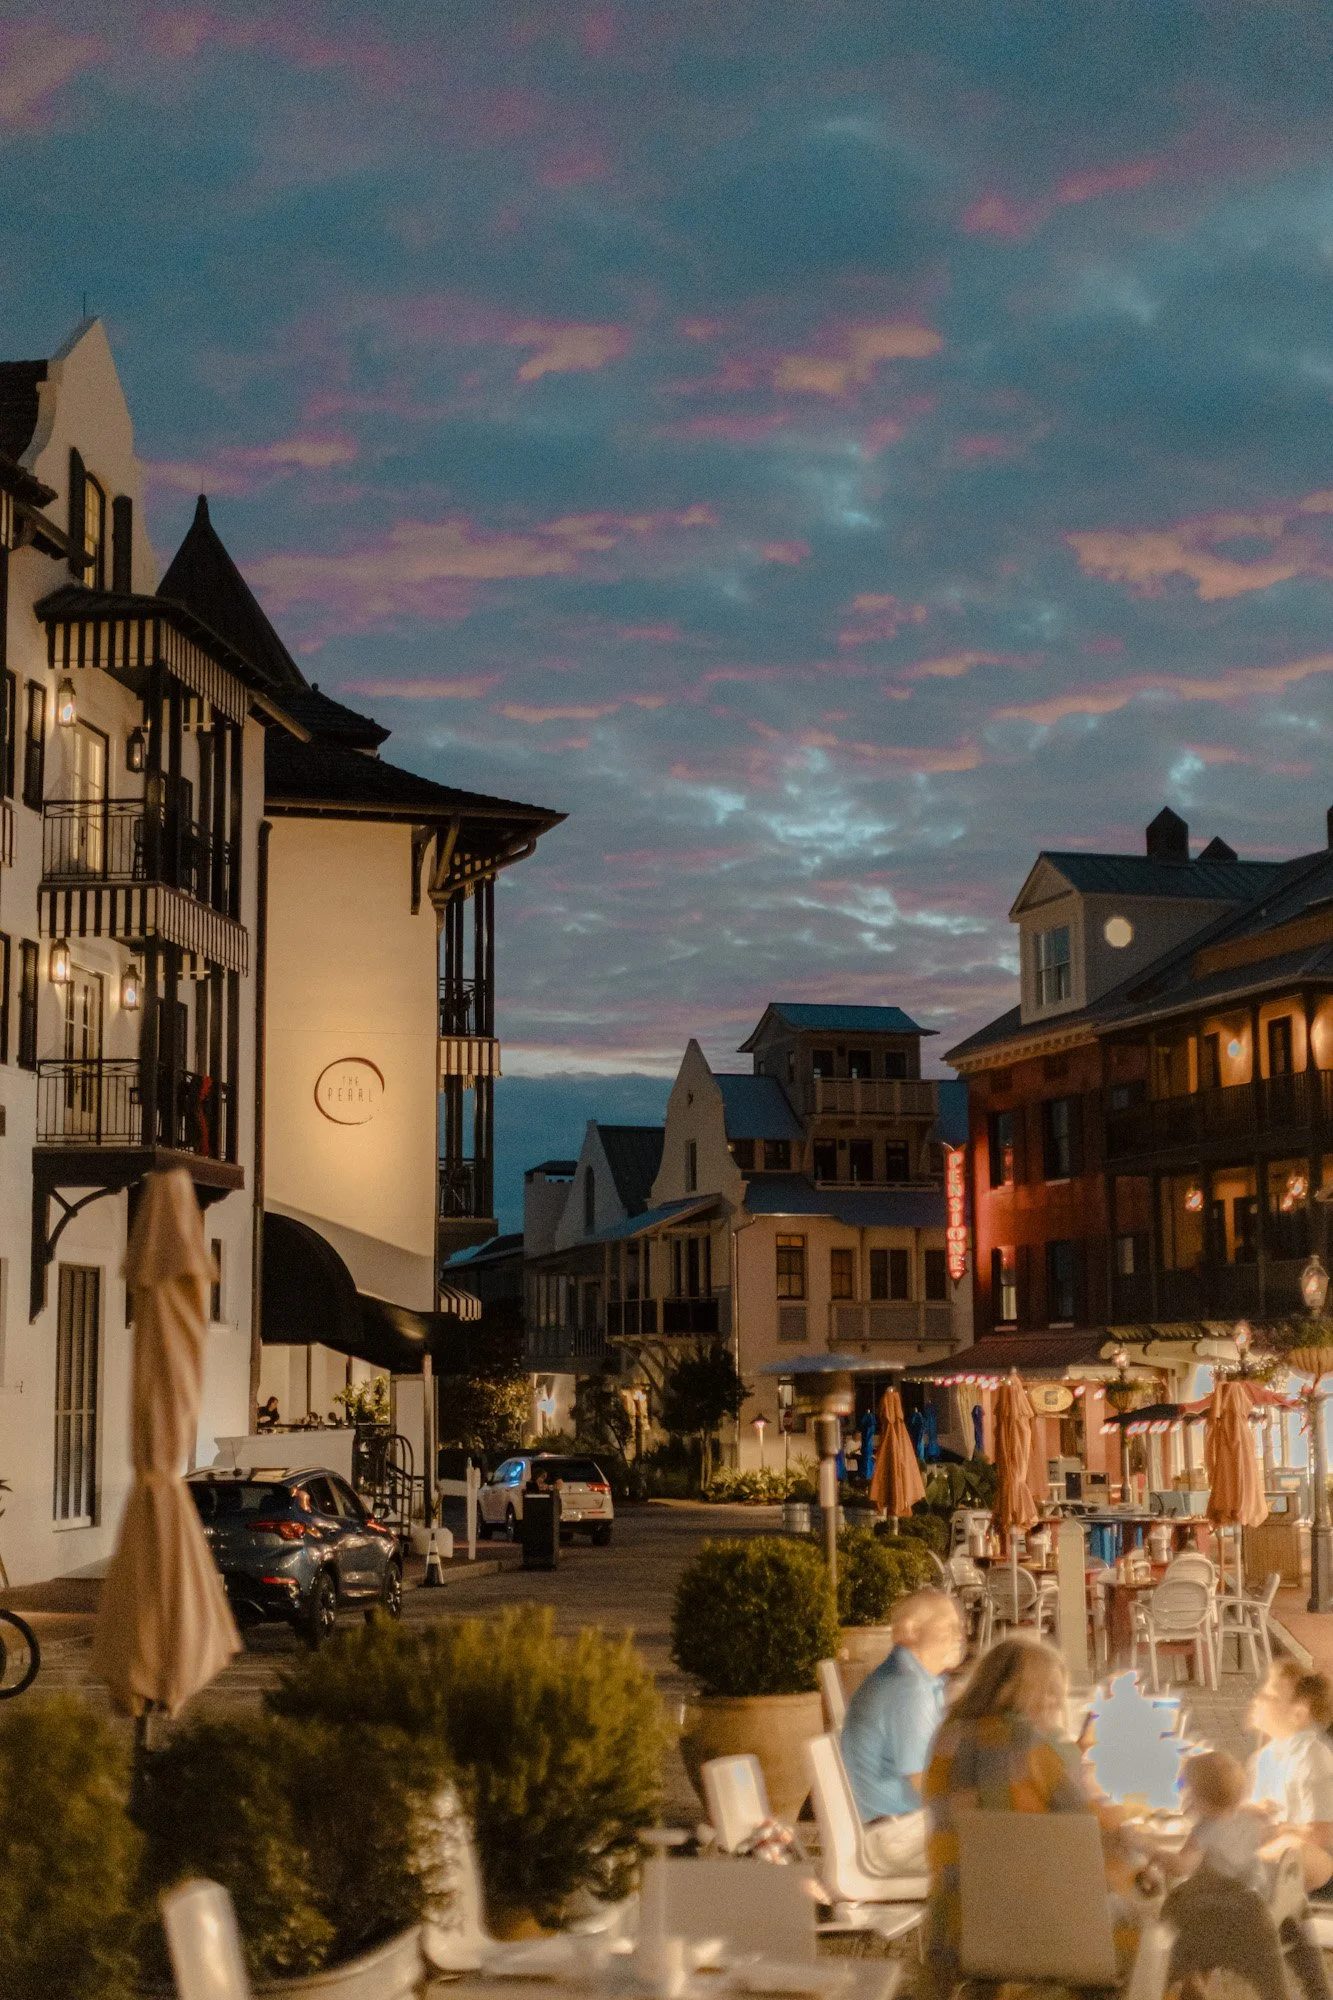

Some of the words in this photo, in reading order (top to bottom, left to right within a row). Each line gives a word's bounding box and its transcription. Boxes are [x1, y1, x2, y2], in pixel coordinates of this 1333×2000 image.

[342, 1076, 359, 1087] THE
[328, 1088, 373, 1102] PEARL
[947, 1150, 966, 1271] PENSIONE
